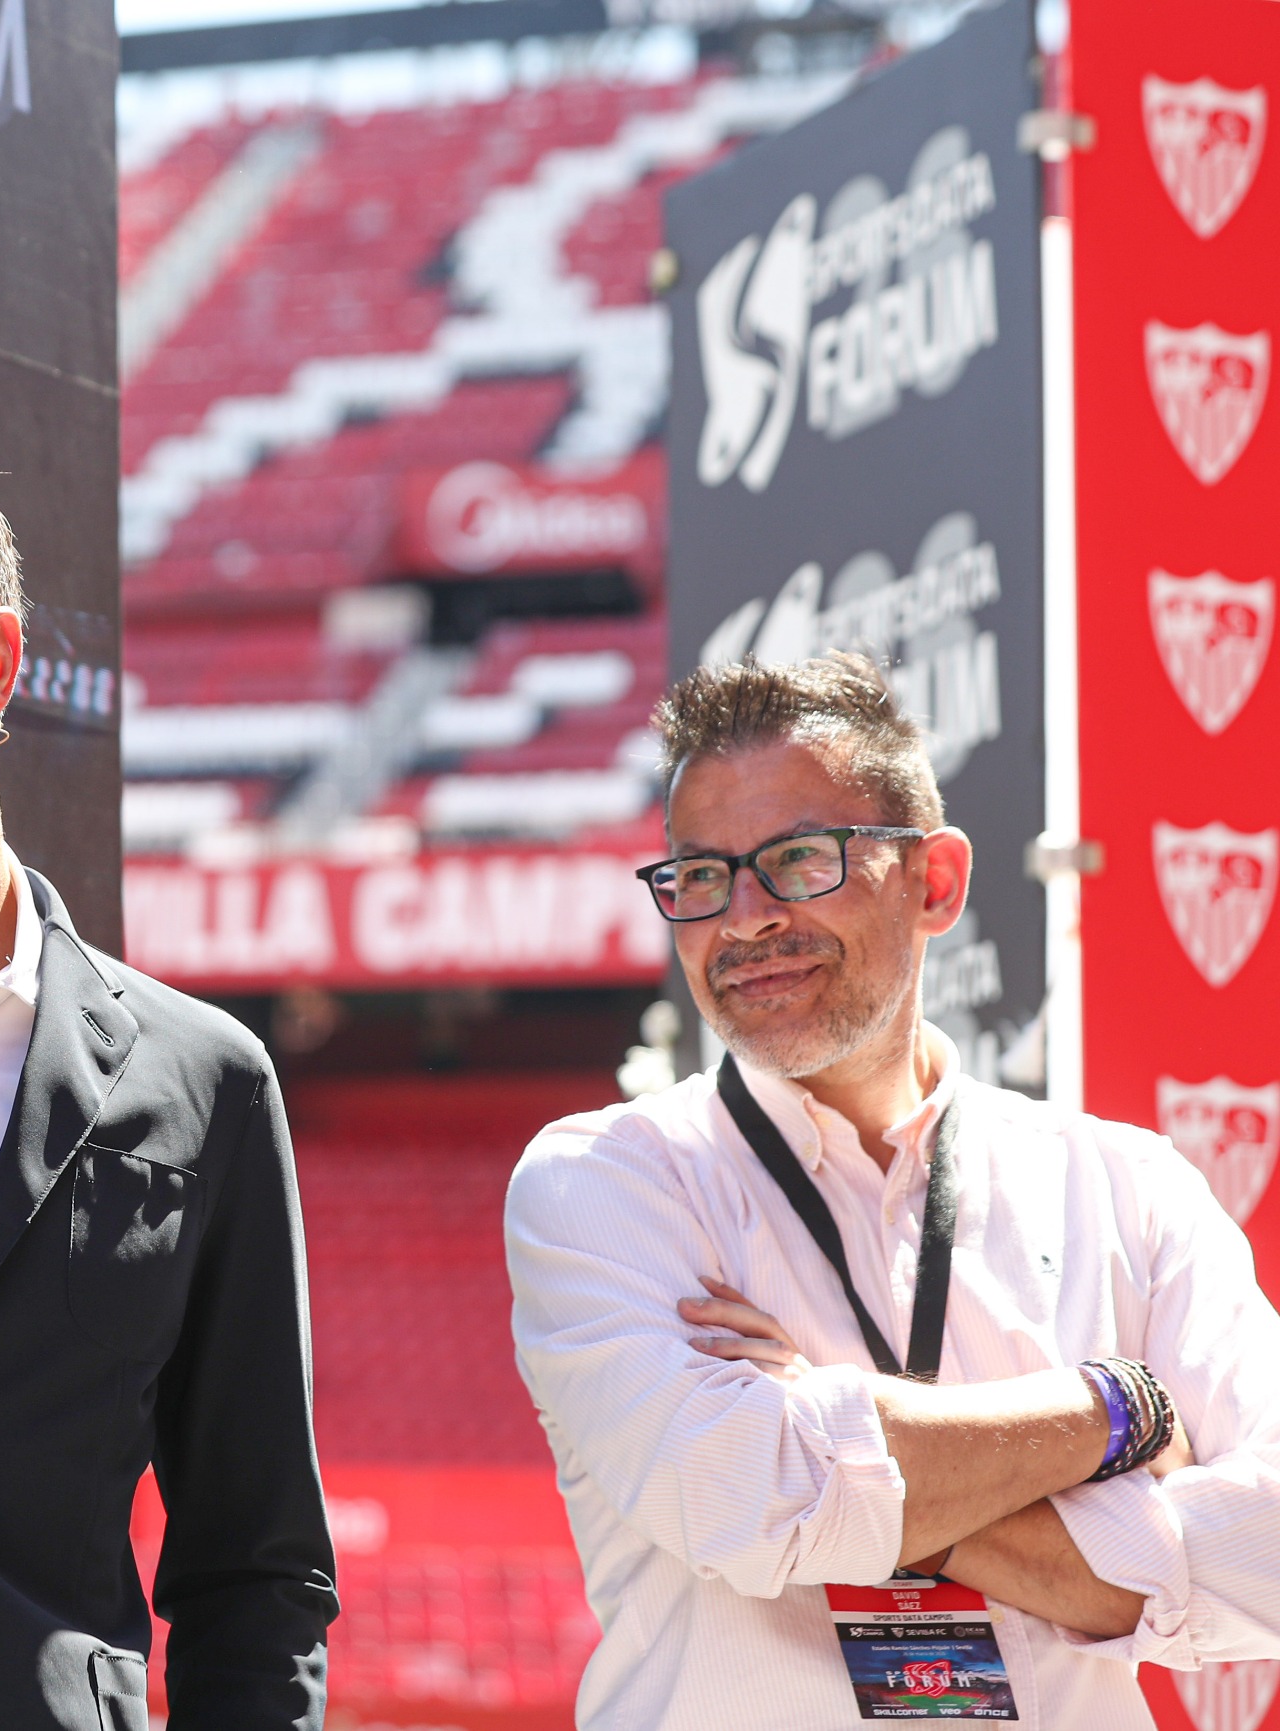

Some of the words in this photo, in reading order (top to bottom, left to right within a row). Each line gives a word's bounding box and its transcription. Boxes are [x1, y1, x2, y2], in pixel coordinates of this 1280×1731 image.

[807, 238, 999, 430] FORUM
[892, 1591, 921, 1600] DAVID
[897, 1600, 922, 1611] SÁEZ
[873, 1614, 902, 1622] SPORTS
[923, 1613, 954, 1621] CAMPUS
[935, 1628, 948, 1636] FC
[886, 1674, 972, 1688] FORUM
